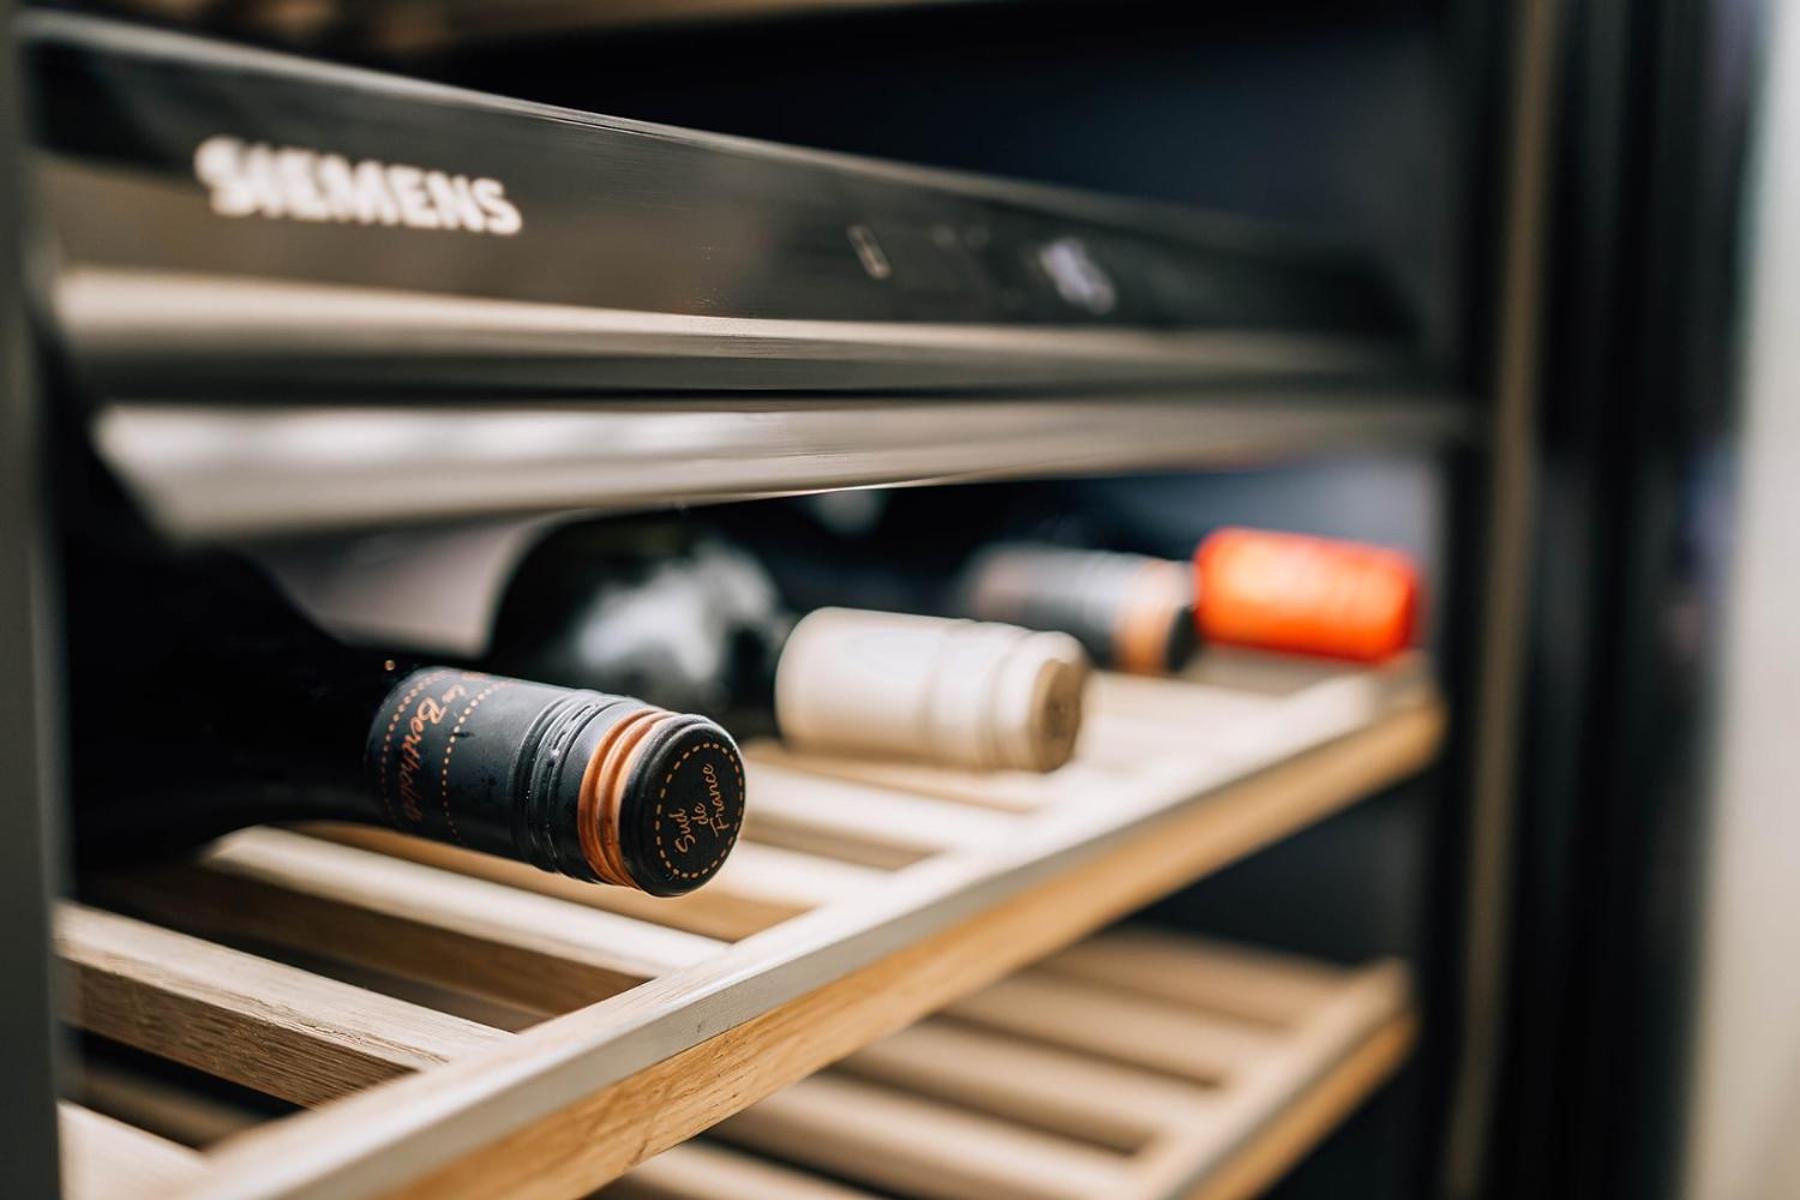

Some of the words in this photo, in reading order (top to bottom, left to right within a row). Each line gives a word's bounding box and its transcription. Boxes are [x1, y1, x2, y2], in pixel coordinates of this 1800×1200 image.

[194, 138, 523, 235] SIEMENS
[668, 808, 696, 853] Sud
[691, 802, 709, 825] de
[702, 763, 730, 838] France
